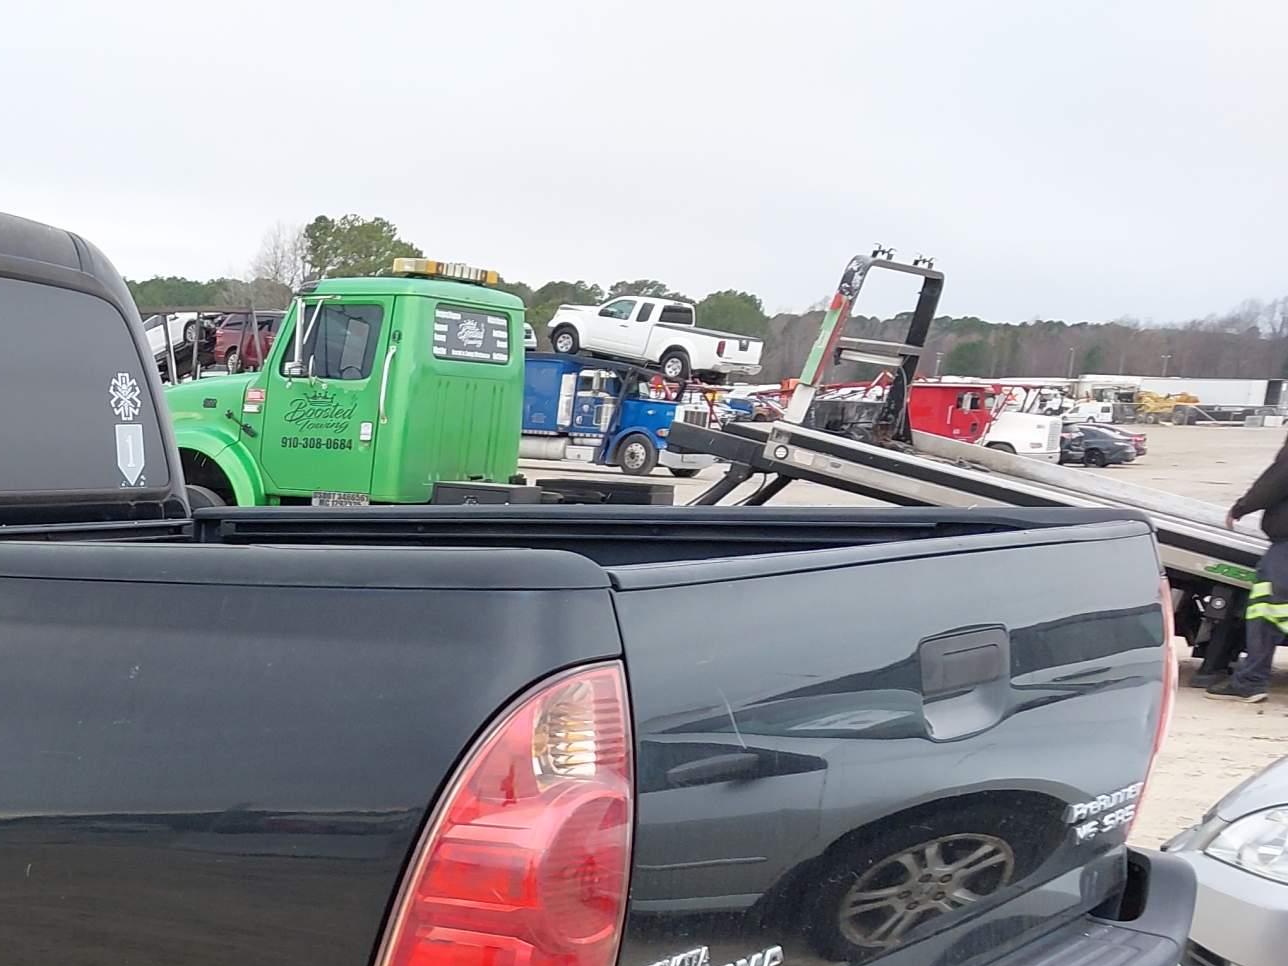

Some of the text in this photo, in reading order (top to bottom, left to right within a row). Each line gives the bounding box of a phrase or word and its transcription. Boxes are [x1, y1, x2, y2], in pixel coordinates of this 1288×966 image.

[284, 398, 358, 422] Boosted
[295, 419, 349, 434] Towing
[280, 436, 353, 450] 910-308-0684
